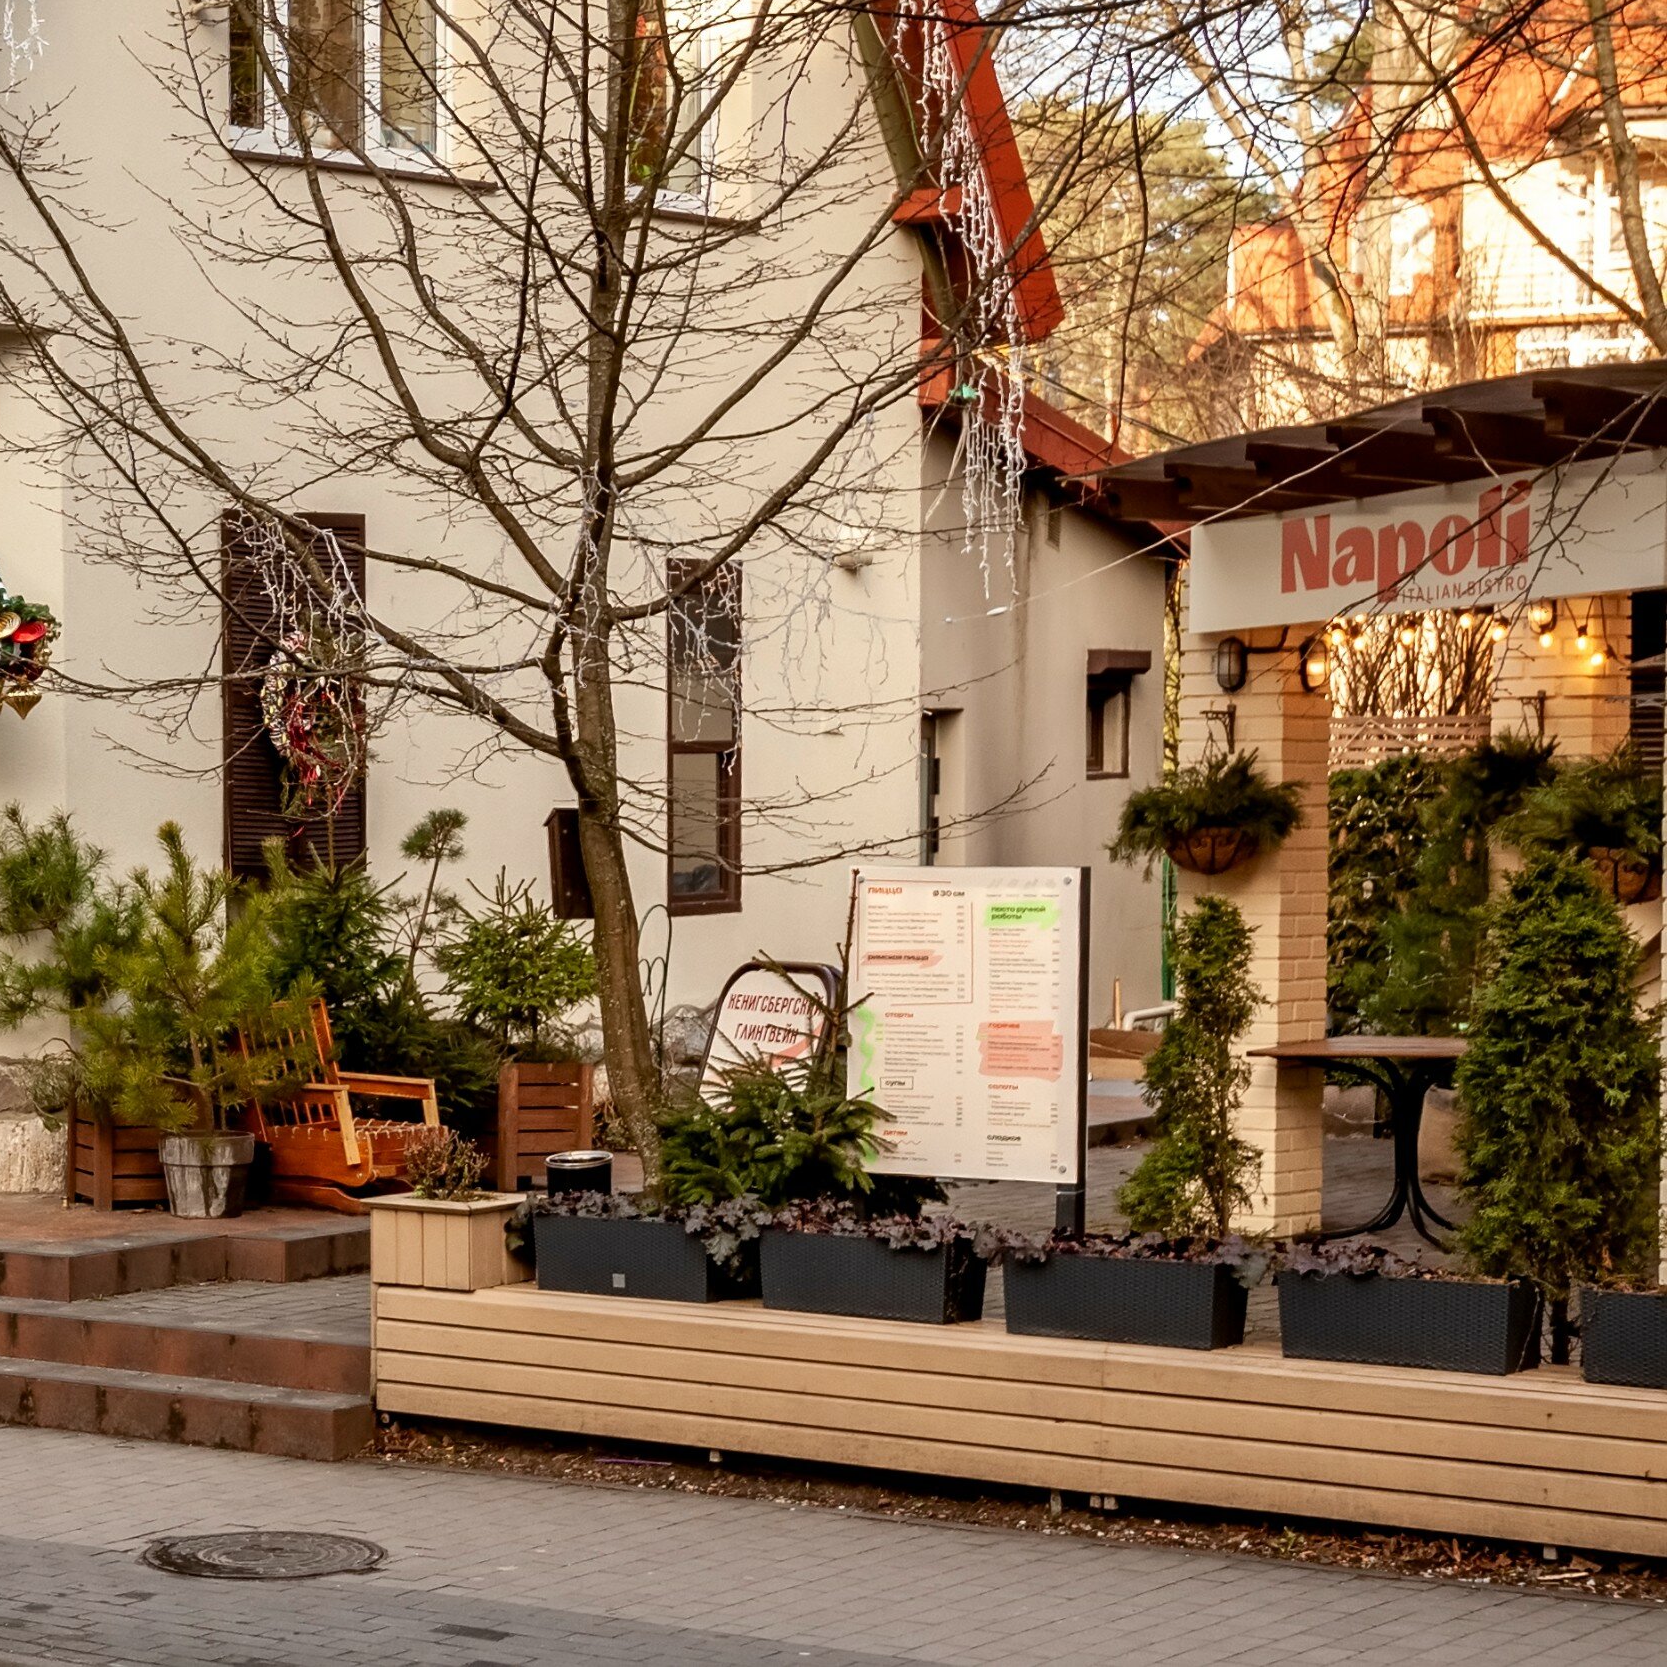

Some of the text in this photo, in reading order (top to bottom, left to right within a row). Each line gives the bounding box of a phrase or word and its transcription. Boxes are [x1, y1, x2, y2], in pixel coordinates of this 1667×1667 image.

[1281, 480, 1534, 603] Napoli
[1402, 574, 1528, 604] ITALIAN BISTRO
[734, 1023, 798, 1044] ГЛИНТВЕЙН
